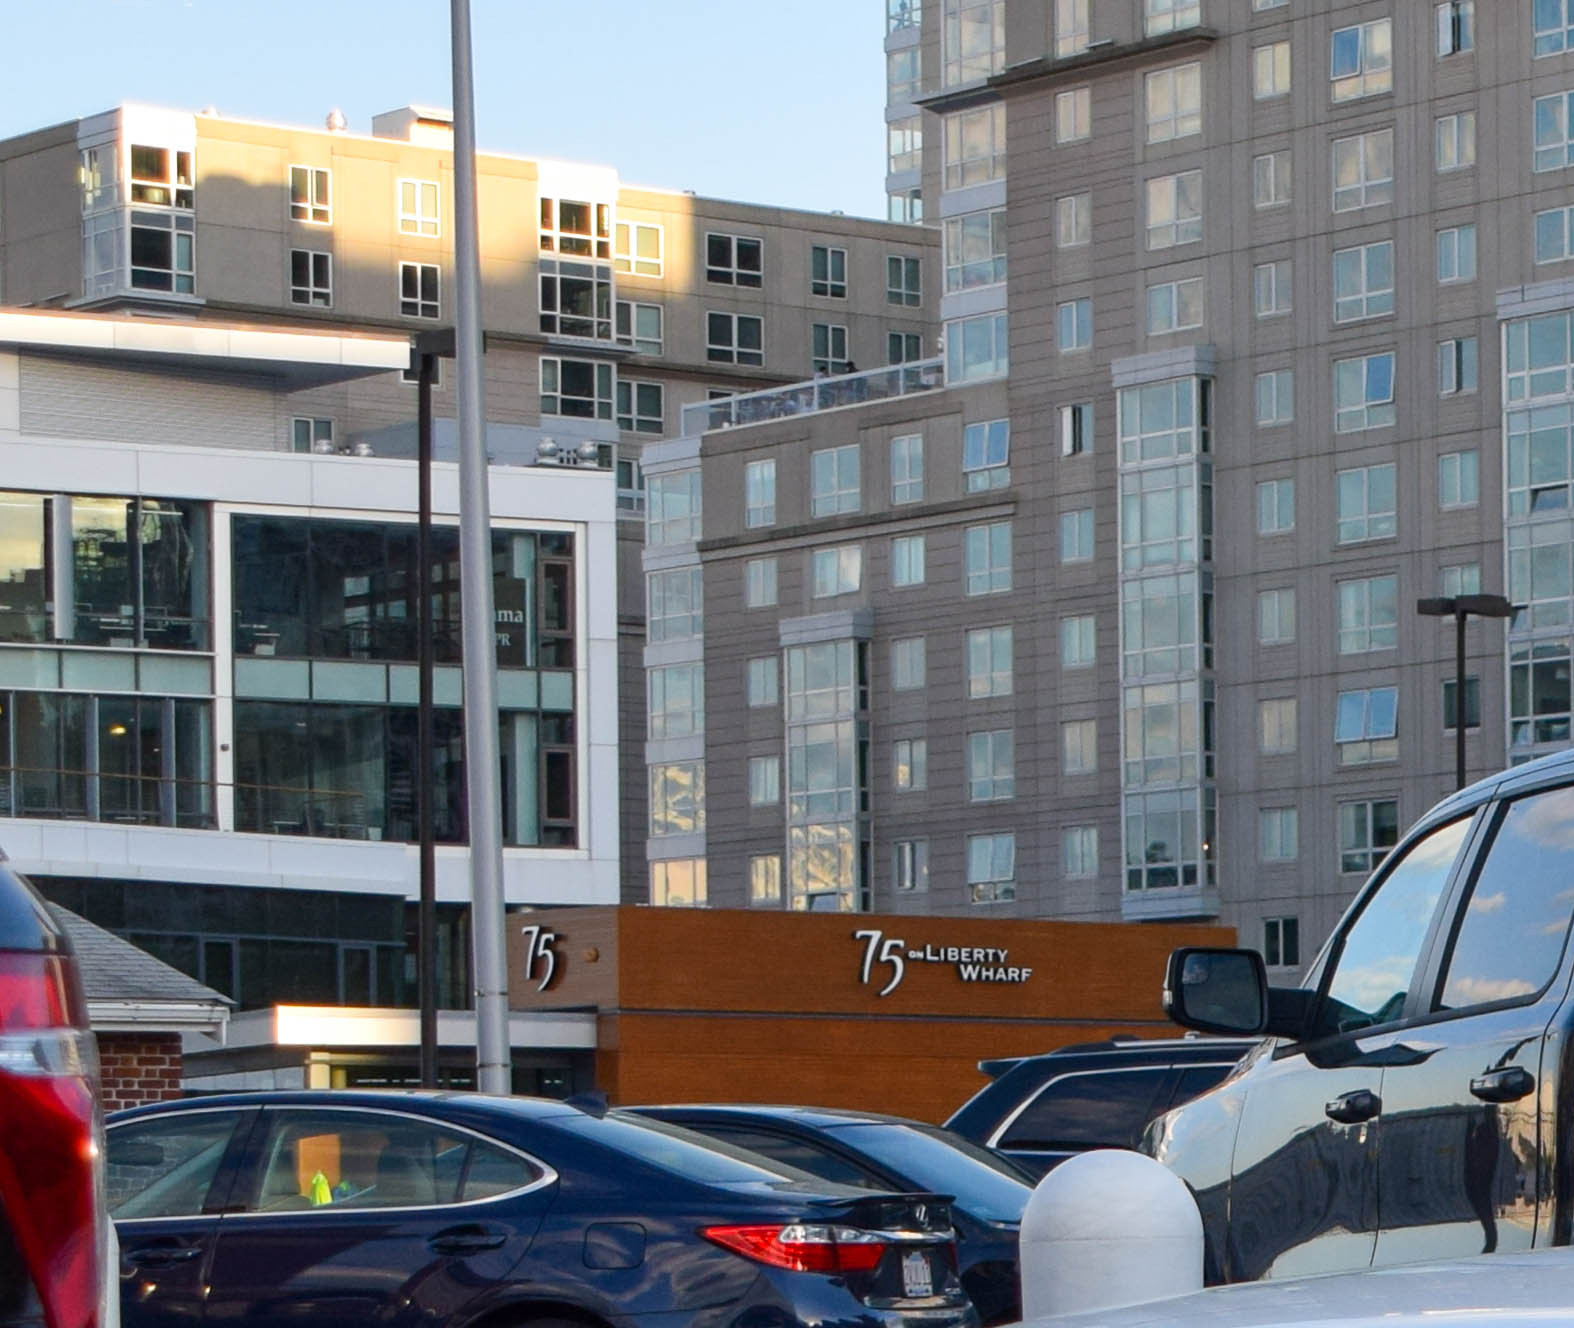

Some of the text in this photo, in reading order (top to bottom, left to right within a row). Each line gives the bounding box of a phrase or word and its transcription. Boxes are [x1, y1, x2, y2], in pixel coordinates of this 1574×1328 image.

[521, 925, 555, 992] 75
[855, 929, 1008, 996] 75 ON LIBERTY
[959, 964, 1032, 982] WHARF
